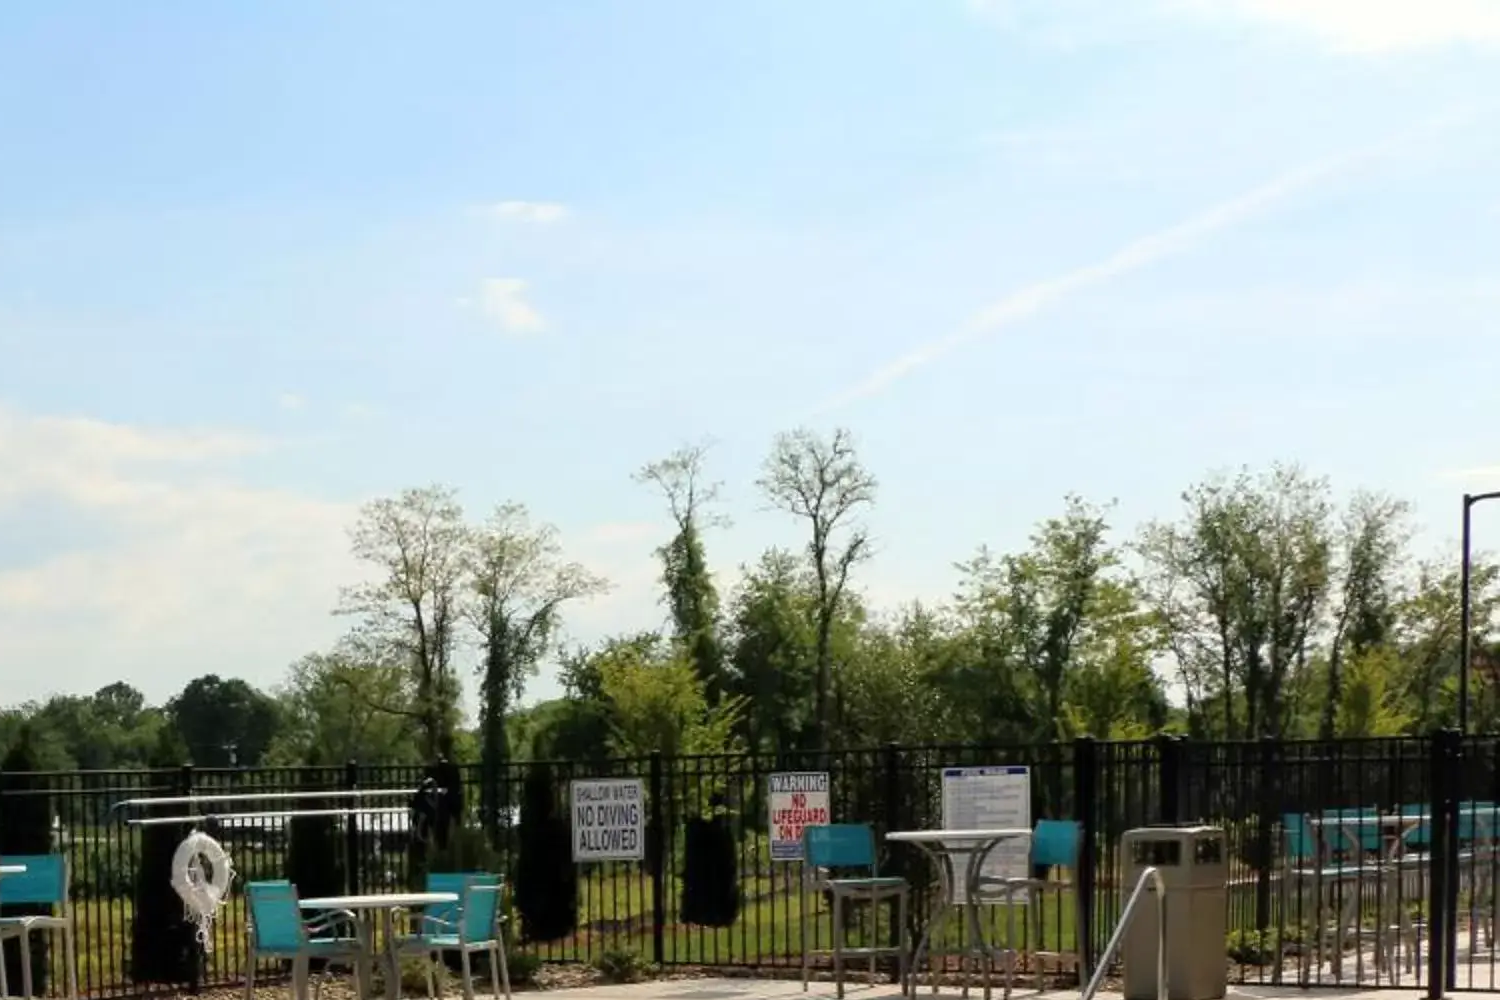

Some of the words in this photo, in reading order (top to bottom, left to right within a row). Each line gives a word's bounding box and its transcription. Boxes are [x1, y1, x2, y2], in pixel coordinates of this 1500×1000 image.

[792, 793, 806, 808] NO
[578, 806, 594, 827] NO
[598, 804, 639, 826] DIVING
[773, 808, 827, 824] LIFEGUARD
[580, 829, 637, 851] ALLOWED
